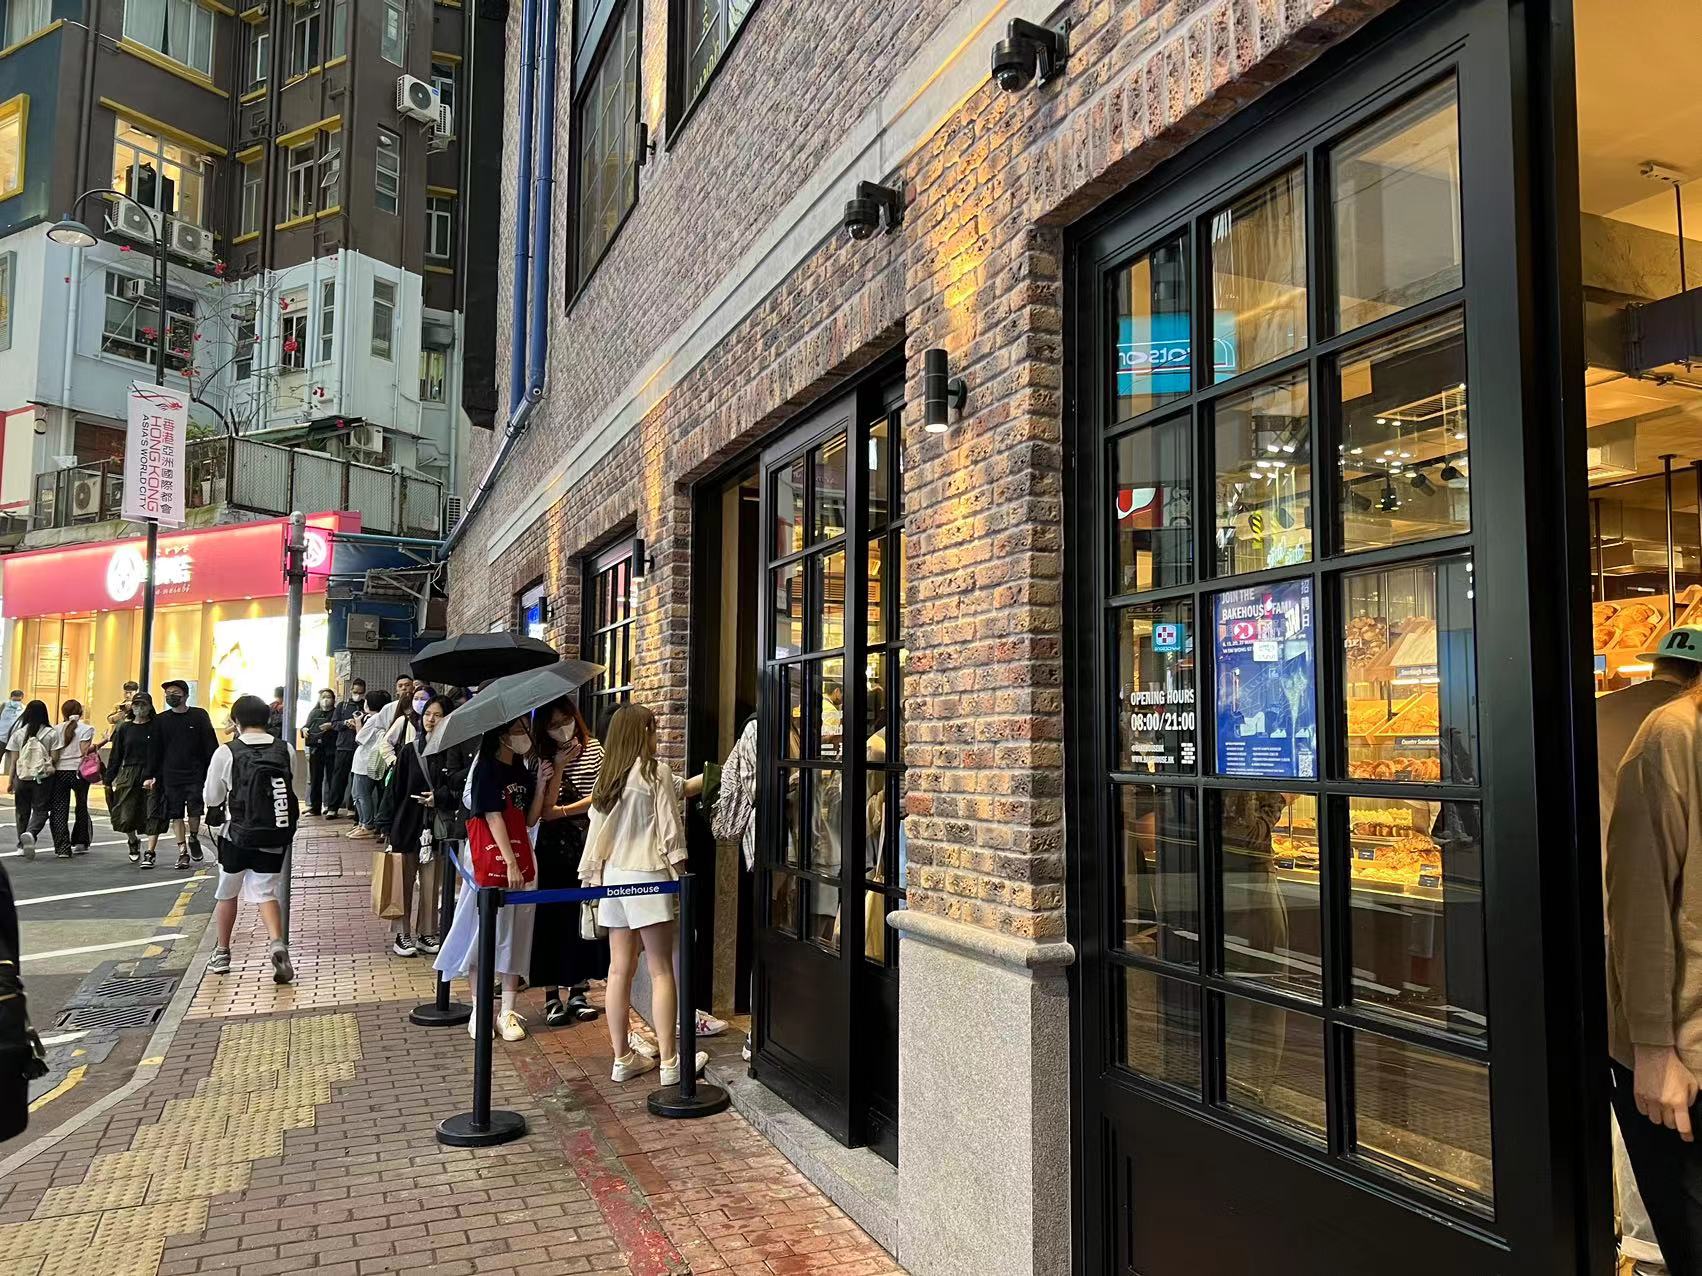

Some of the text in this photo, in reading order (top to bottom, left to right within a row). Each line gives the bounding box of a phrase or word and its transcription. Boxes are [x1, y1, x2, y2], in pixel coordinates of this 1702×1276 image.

[139, 414, 150, 511] ASIA'S WORLD CITY
[147, 415, 162, 513] HONG KONG
[160, 418, 175, 515] 香港亞洲國際都會
[1222, 588, 1255, 604] JOIN THE
[1130, 688, 1195, 706] OPENING HOURS
[1130, 711, 1195, 731] 08:00/21:00
[271, 776, 289, 828] arena
[606, 884, 660, 897] bakehouse
